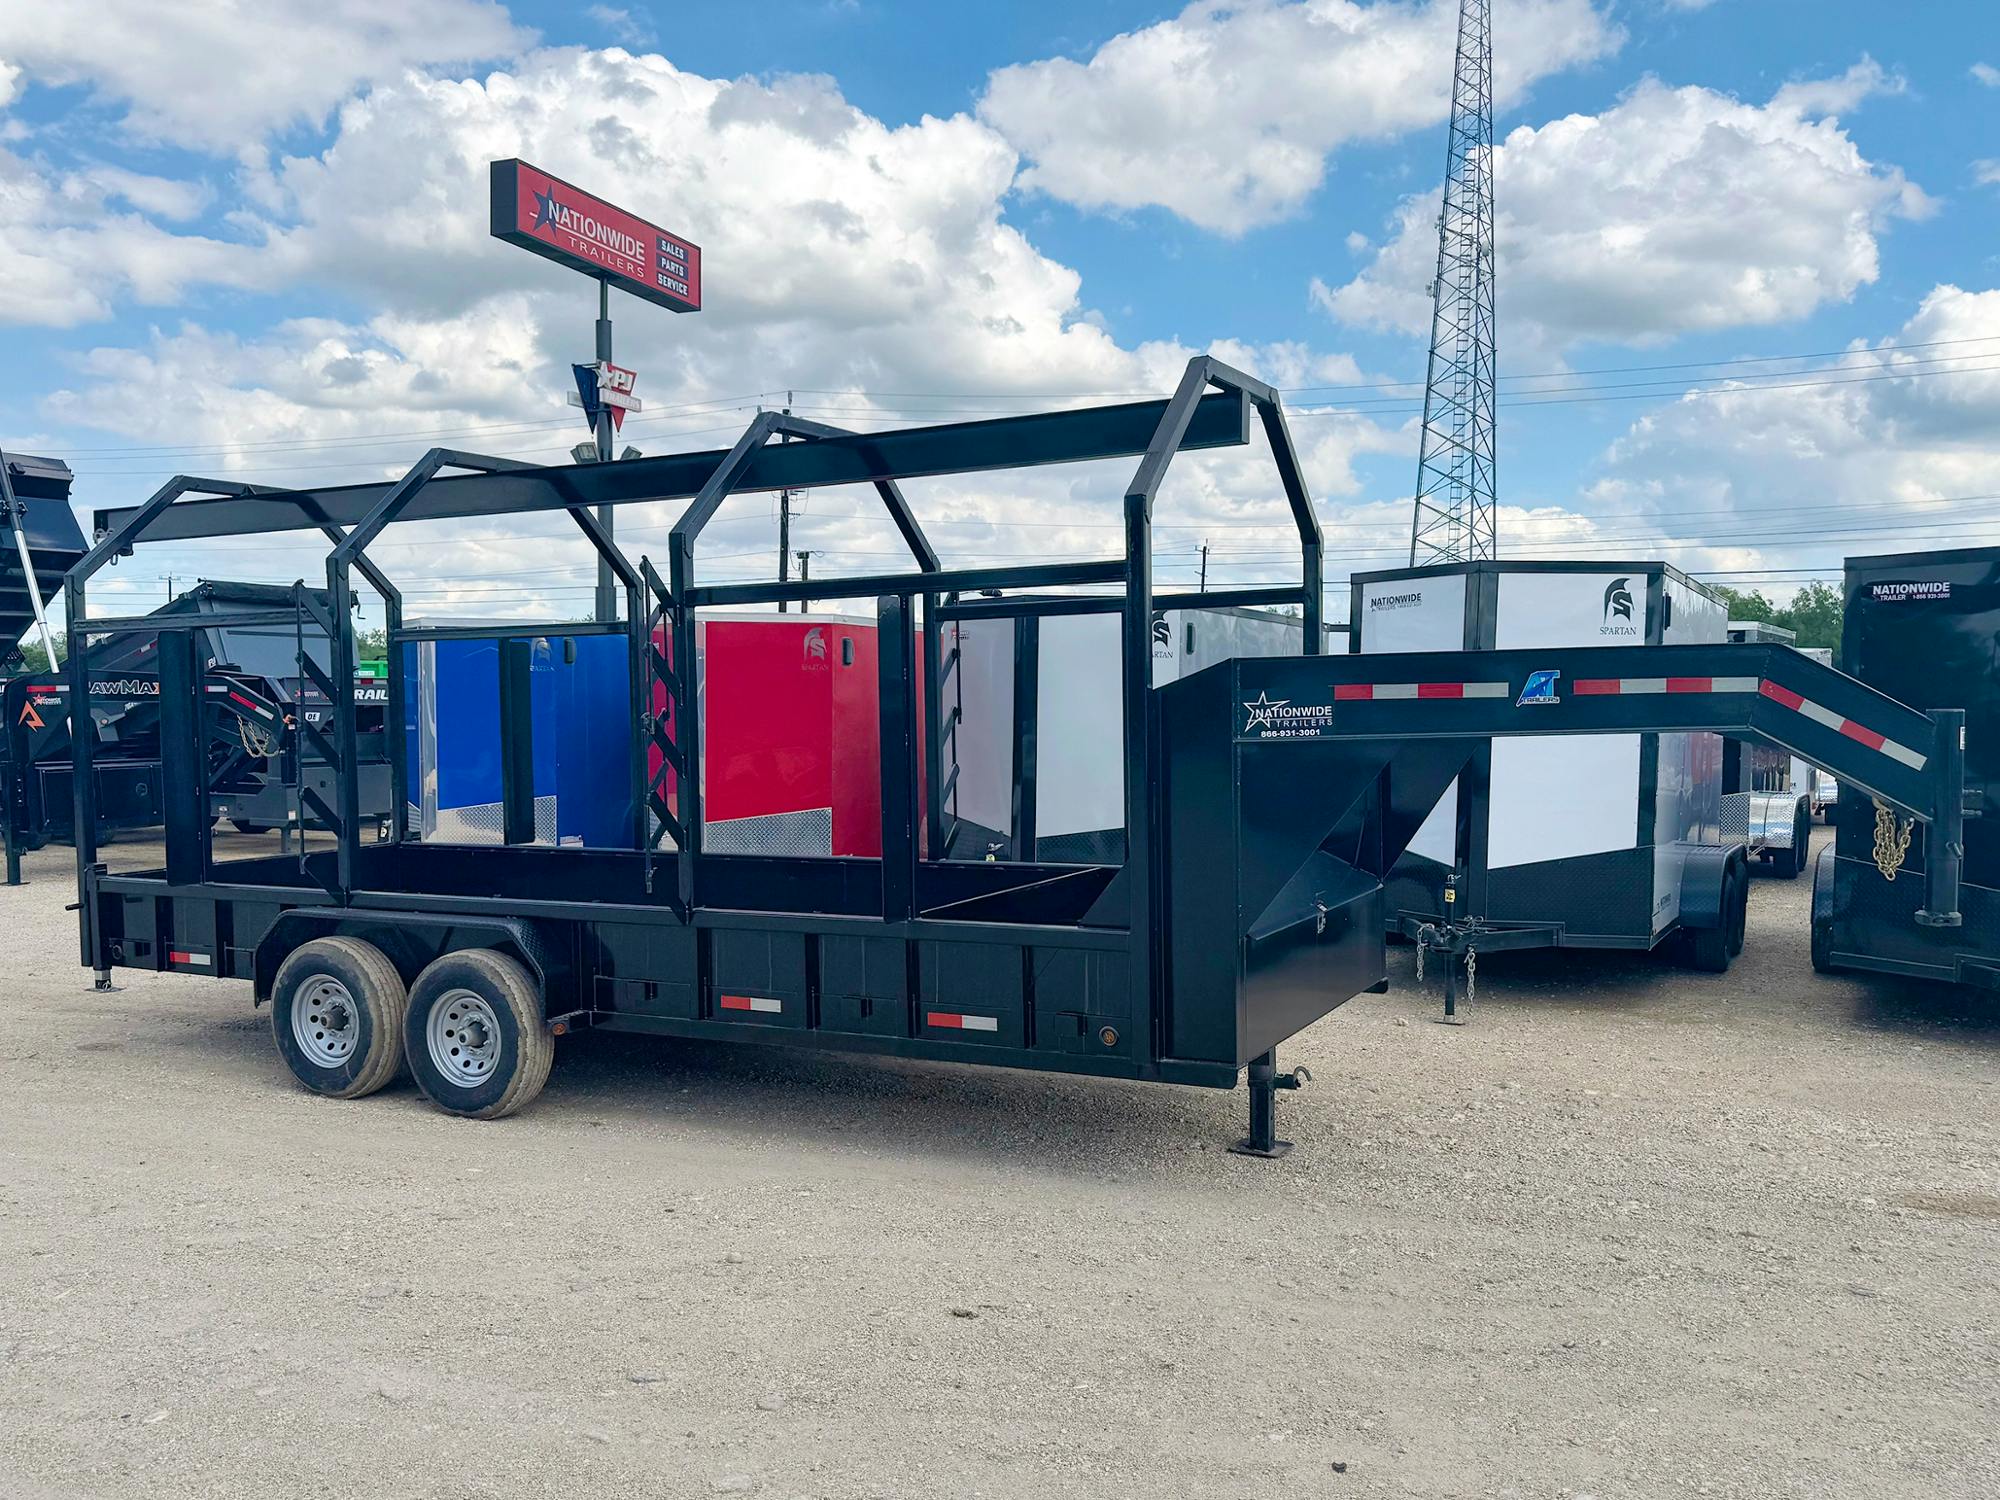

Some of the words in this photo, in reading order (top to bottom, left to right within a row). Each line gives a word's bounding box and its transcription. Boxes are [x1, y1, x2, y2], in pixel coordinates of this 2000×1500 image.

[548, 199, 645, 261] NATIONWIDE
[661, 239, 684, 260] SALES
[568, 236, 645, 278] TRAILERS
[661, 257, 684, 277] PARTS
[657, 273, 688, 296] SERVICE
[613, 370, 634, 391] PJ
[1873, 582, 1950, 595] NATIONWIDE
[1371, 592, 1422, 607] NATIONWIDE
[1599, 626, 1637, 635] SPARTAN
[1152, 651, 1173, 659] RTAN
[353, 689, 388, 700] RAIL
[1255, 706, 1333, 718] NATIONWIDE
[1276, 718, 1333, 728] TRAILERS
[1260, 729, 1321, 738] 866-931-3001
